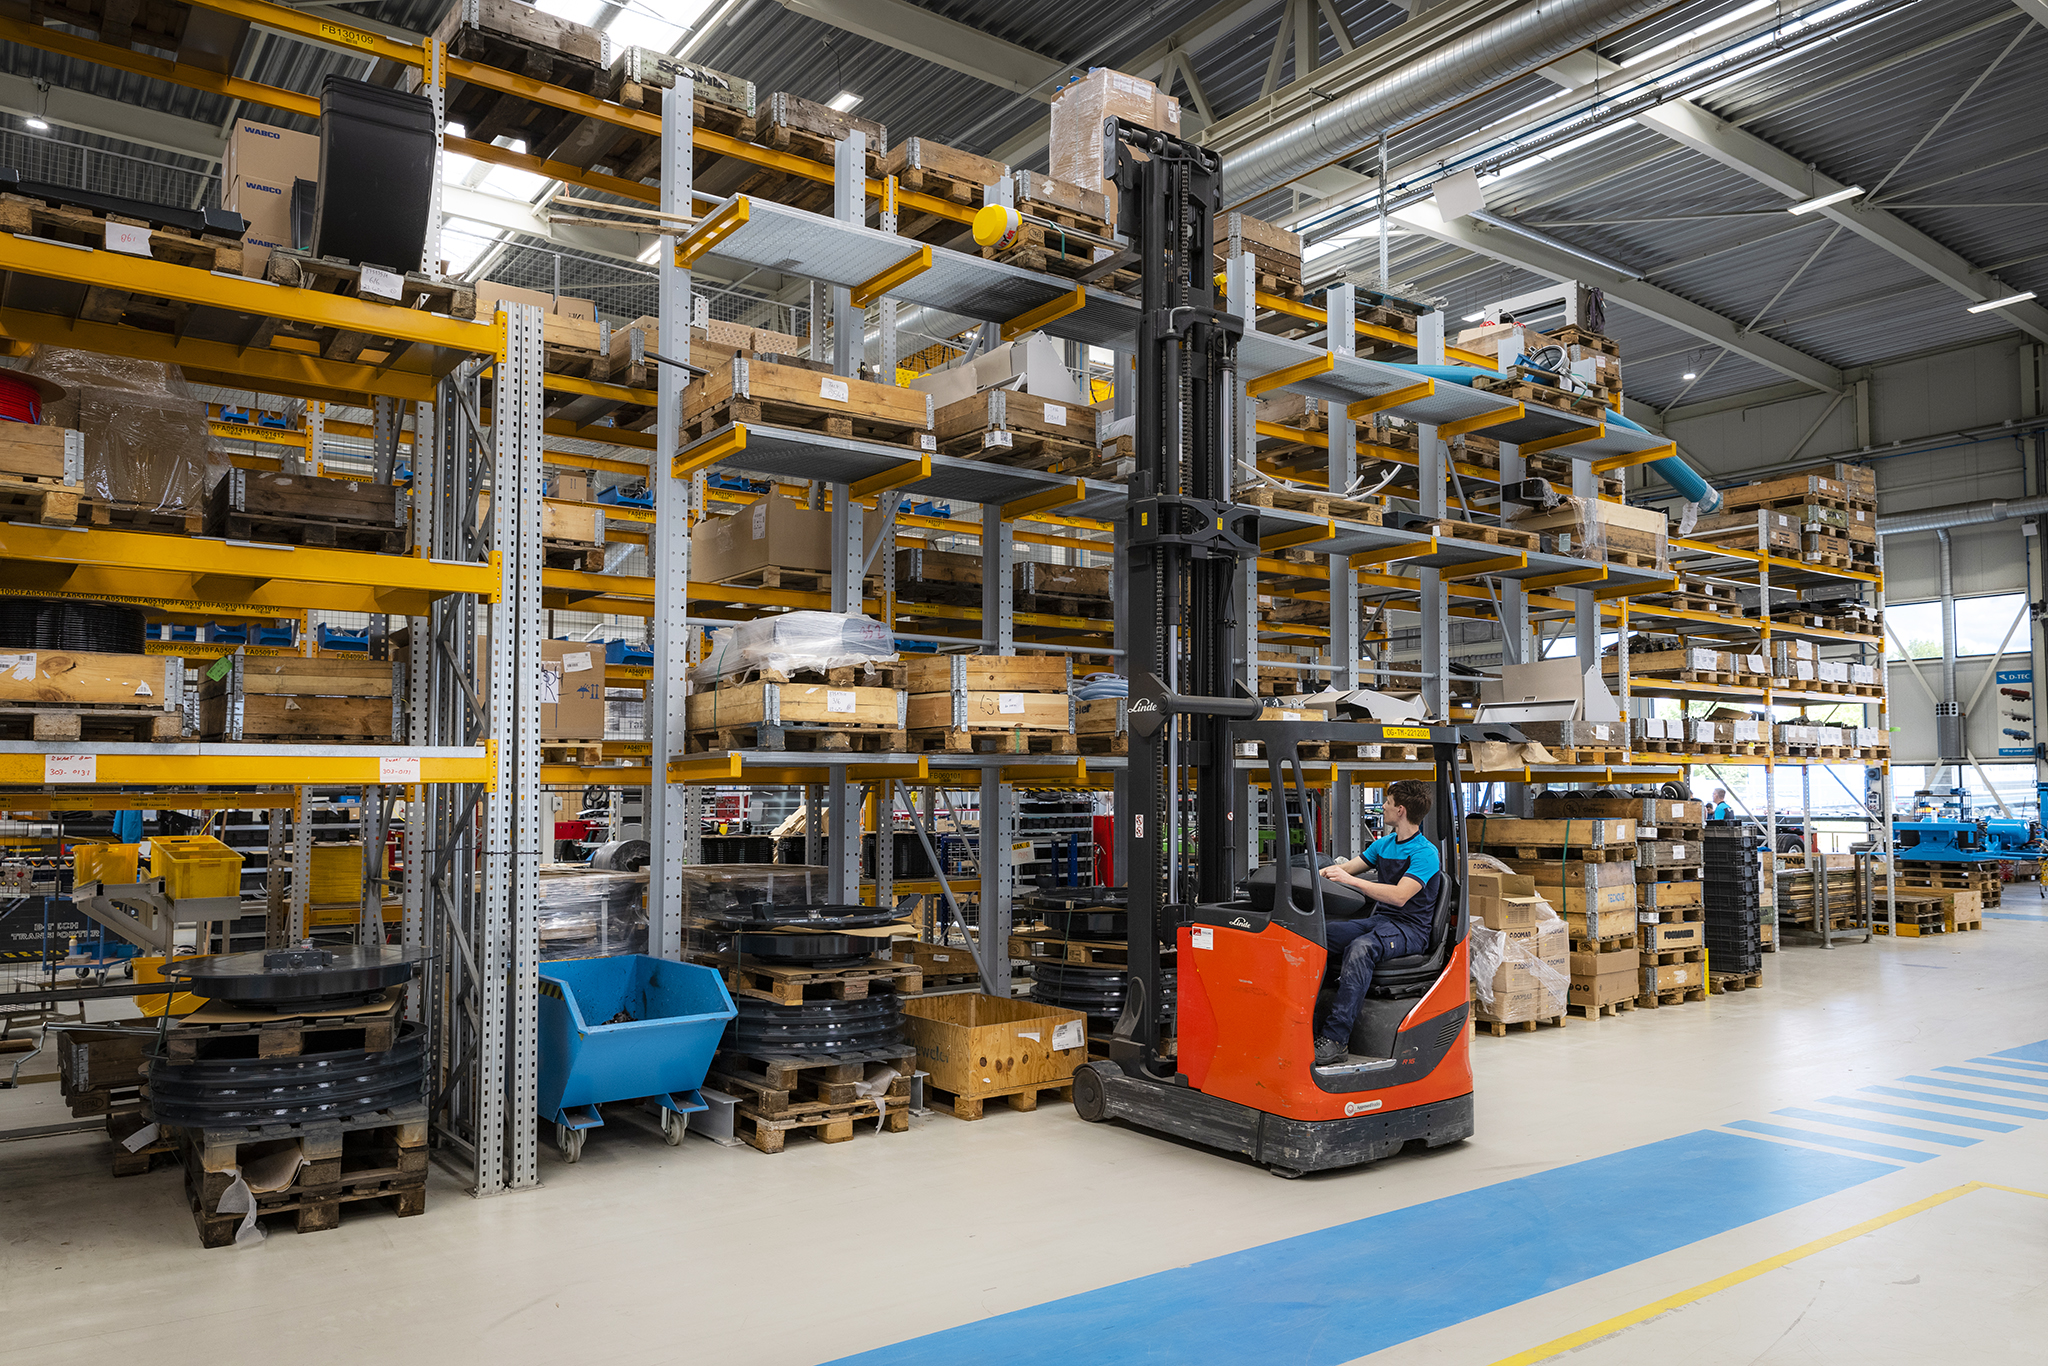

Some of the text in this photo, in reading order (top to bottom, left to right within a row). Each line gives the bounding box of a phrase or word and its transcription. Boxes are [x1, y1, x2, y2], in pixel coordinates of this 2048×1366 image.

[321, 23, 374, 45] FB130109
[244, 126, 281, 140] WABCO
[246, 181, 282, 195] WABCO
[251, 429, 285, 439] FA051412
[0, 588, 19, 596] 1005
[175, 599, 211, 609] FA051010
[211, 602, 246, 610] FA051011
[246, 605, 281, 613] FA051012
[146, 644, 174, 652] 050909
[2008, 673, 2031, 681] D-TEC
[1074, 702, 1092, 715] eler
[1127, 697, 1158, 713] Linde
[1228, 916, 1252, 929] Linde
